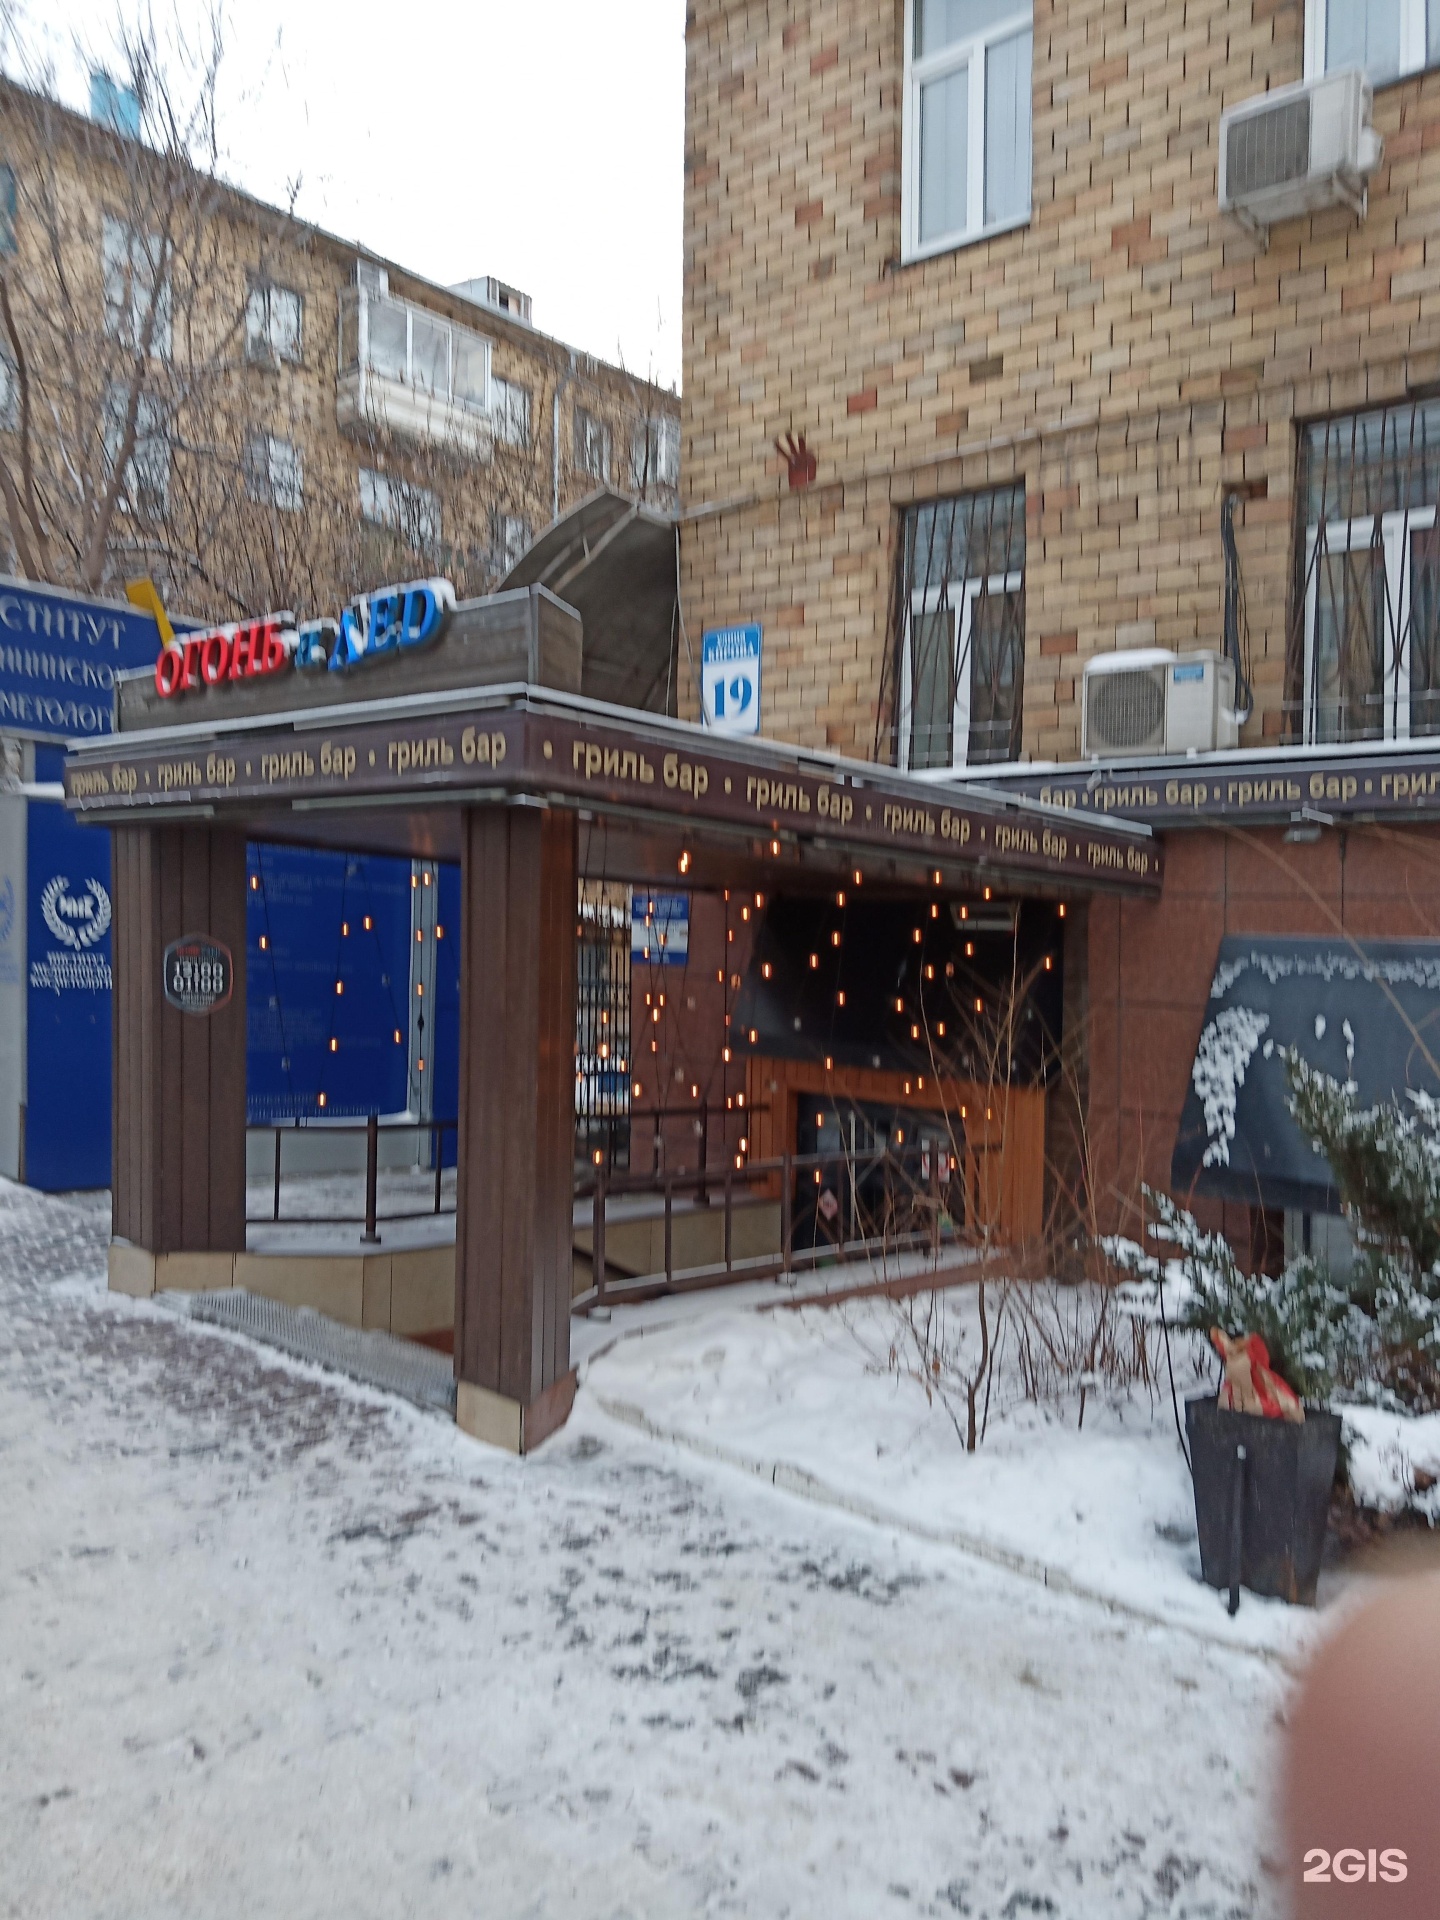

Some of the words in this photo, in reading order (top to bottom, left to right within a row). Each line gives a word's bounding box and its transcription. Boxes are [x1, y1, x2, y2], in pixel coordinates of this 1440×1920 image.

[154, 614, 292, 698] ОГОНЬ
[0, 688, 114, 733] МЕТОЛОГ
[714, 675, 752, 719] 19
[70, 770, 110, 801] гриль
[112, 763, 138, 796] бар
[157, 761, 201, 792] гриль
[206, 752, 236, 788] бар
[261, 751, 315, 785] гриль
[320, 740, 356, 781] бар
[388, 737, 454, 777] гриль
[461, 726, 506, 770] бар
[1040, 786, 1077, 812] бар
[1094, 784, 1158, 813] гриль
[1166, 779, 1208, 810] бар
[1228, 778, 1301, 808] гриль
[1309, 772, 1357, 804] бар
[573, 740, 655, 783] гриль
[663, 753, 709, 799] бар
[747, 776, 811, 813] гриль
[817, 785, 853, 826] бар
[883, 803, 936, 836] гриль
[940, 809, 970, 846] бар
[995, 824, 1038, 854] гриль
[1042, 828, 1067, 862] бар
[1087, 842, 1124, 869] гриль
[1127, 846, 1148, 877] бар
